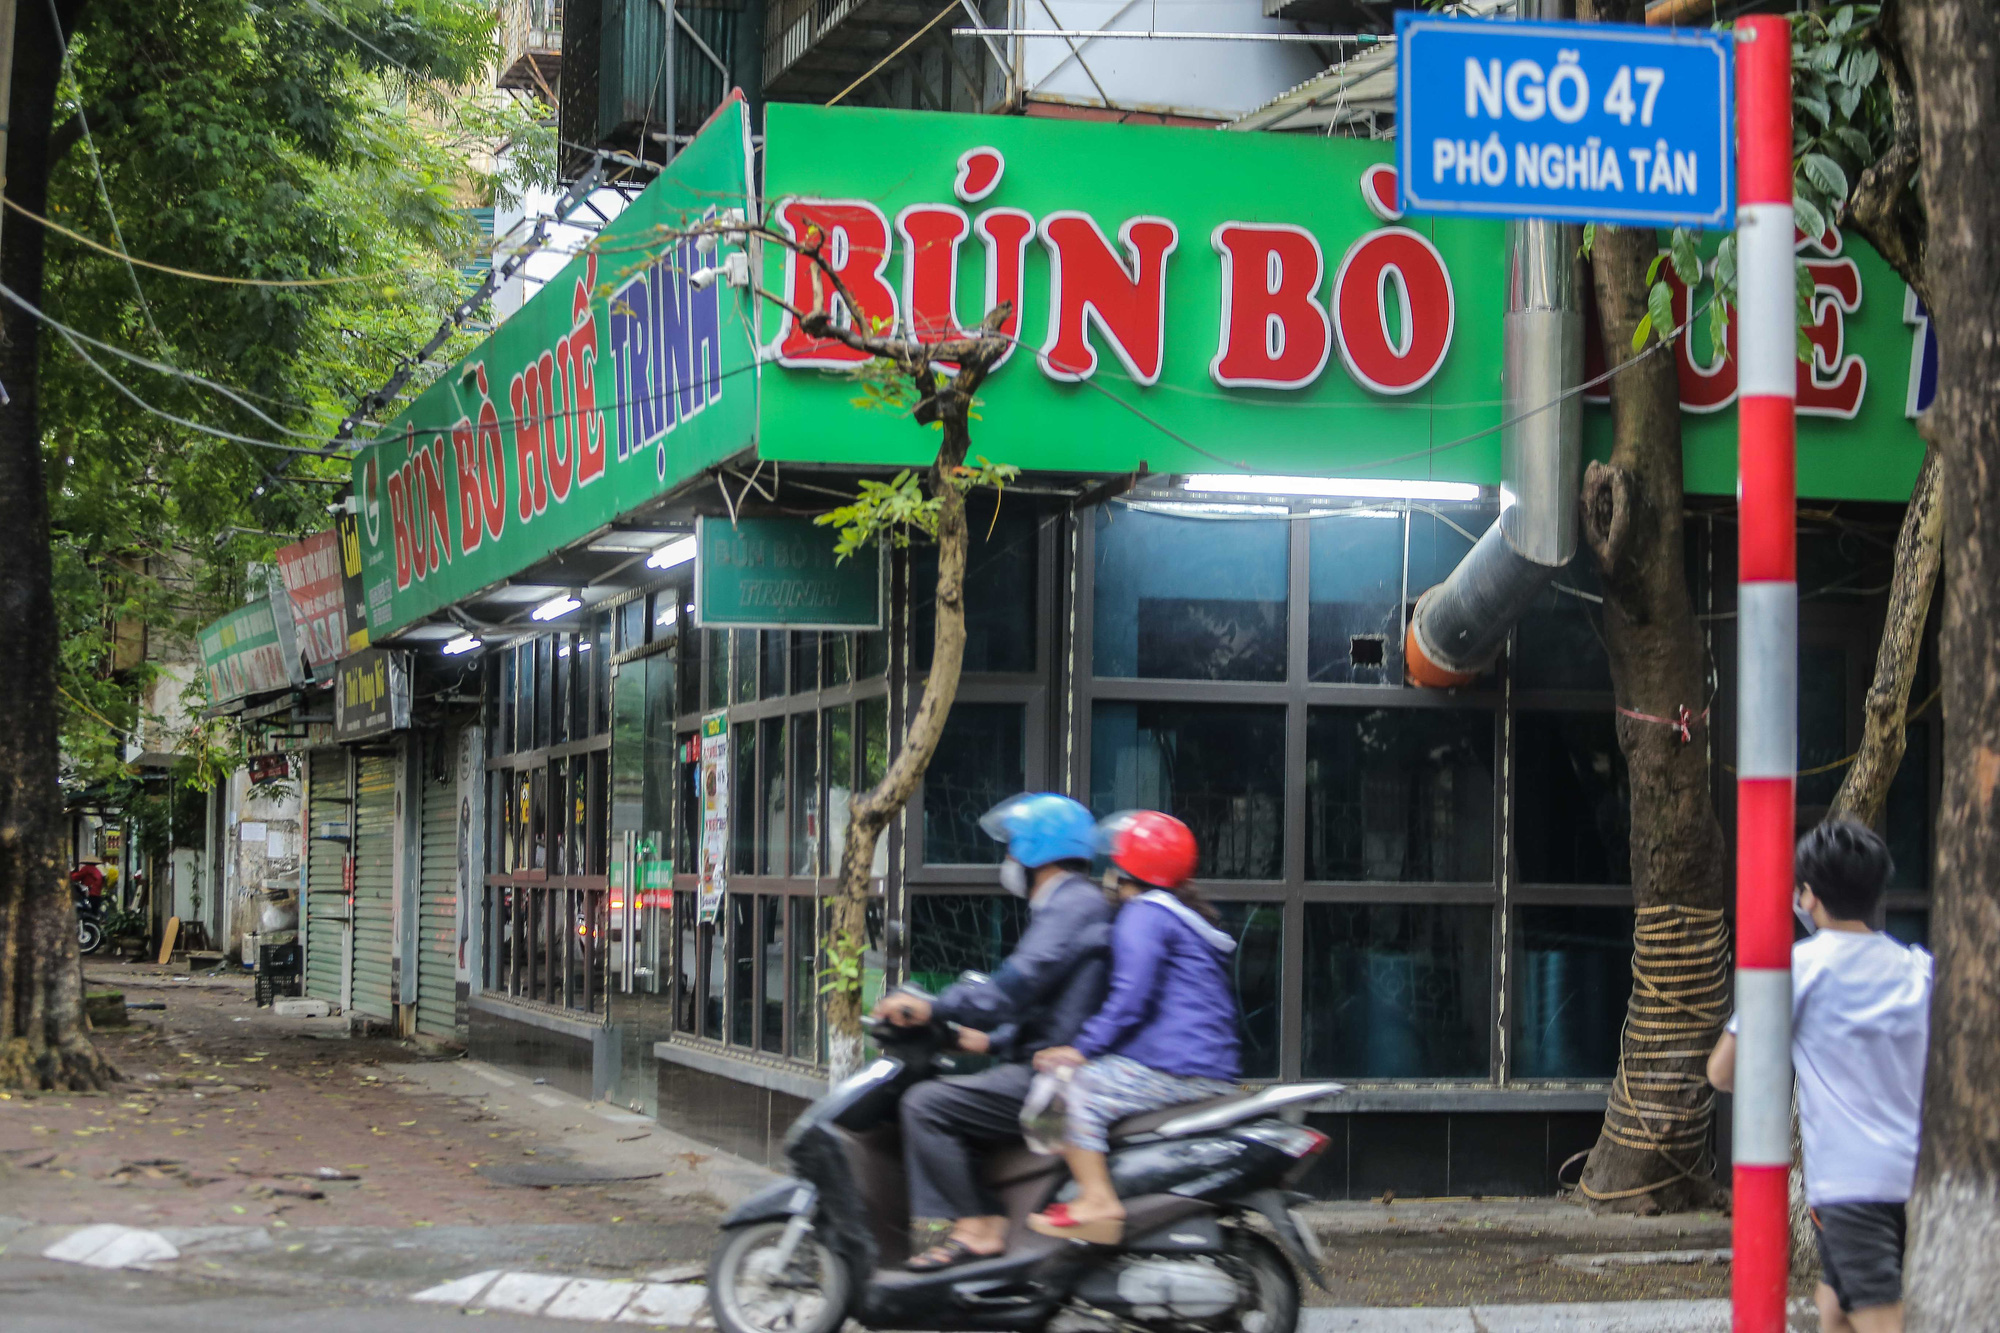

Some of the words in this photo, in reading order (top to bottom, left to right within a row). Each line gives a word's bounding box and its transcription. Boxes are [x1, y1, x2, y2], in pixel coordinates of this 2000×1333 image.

[1465, 49, 1590, 124] NGÕ
[1603, 66, 1665, 127] 47
[1515, 137, 1624, 192] NGHĨA
[1628, 138, 1698, 195] TÂN
[773, 146, 1179, 388] BÚN
[1209, 162, 1455, 396] BÒ
[388, 420, 452, 592] BÚN
[452, 360, 507, 556] BÒ
[510, 252, 606, 526] HUẾ
[607, 203, 723, 483] TRỊNH
